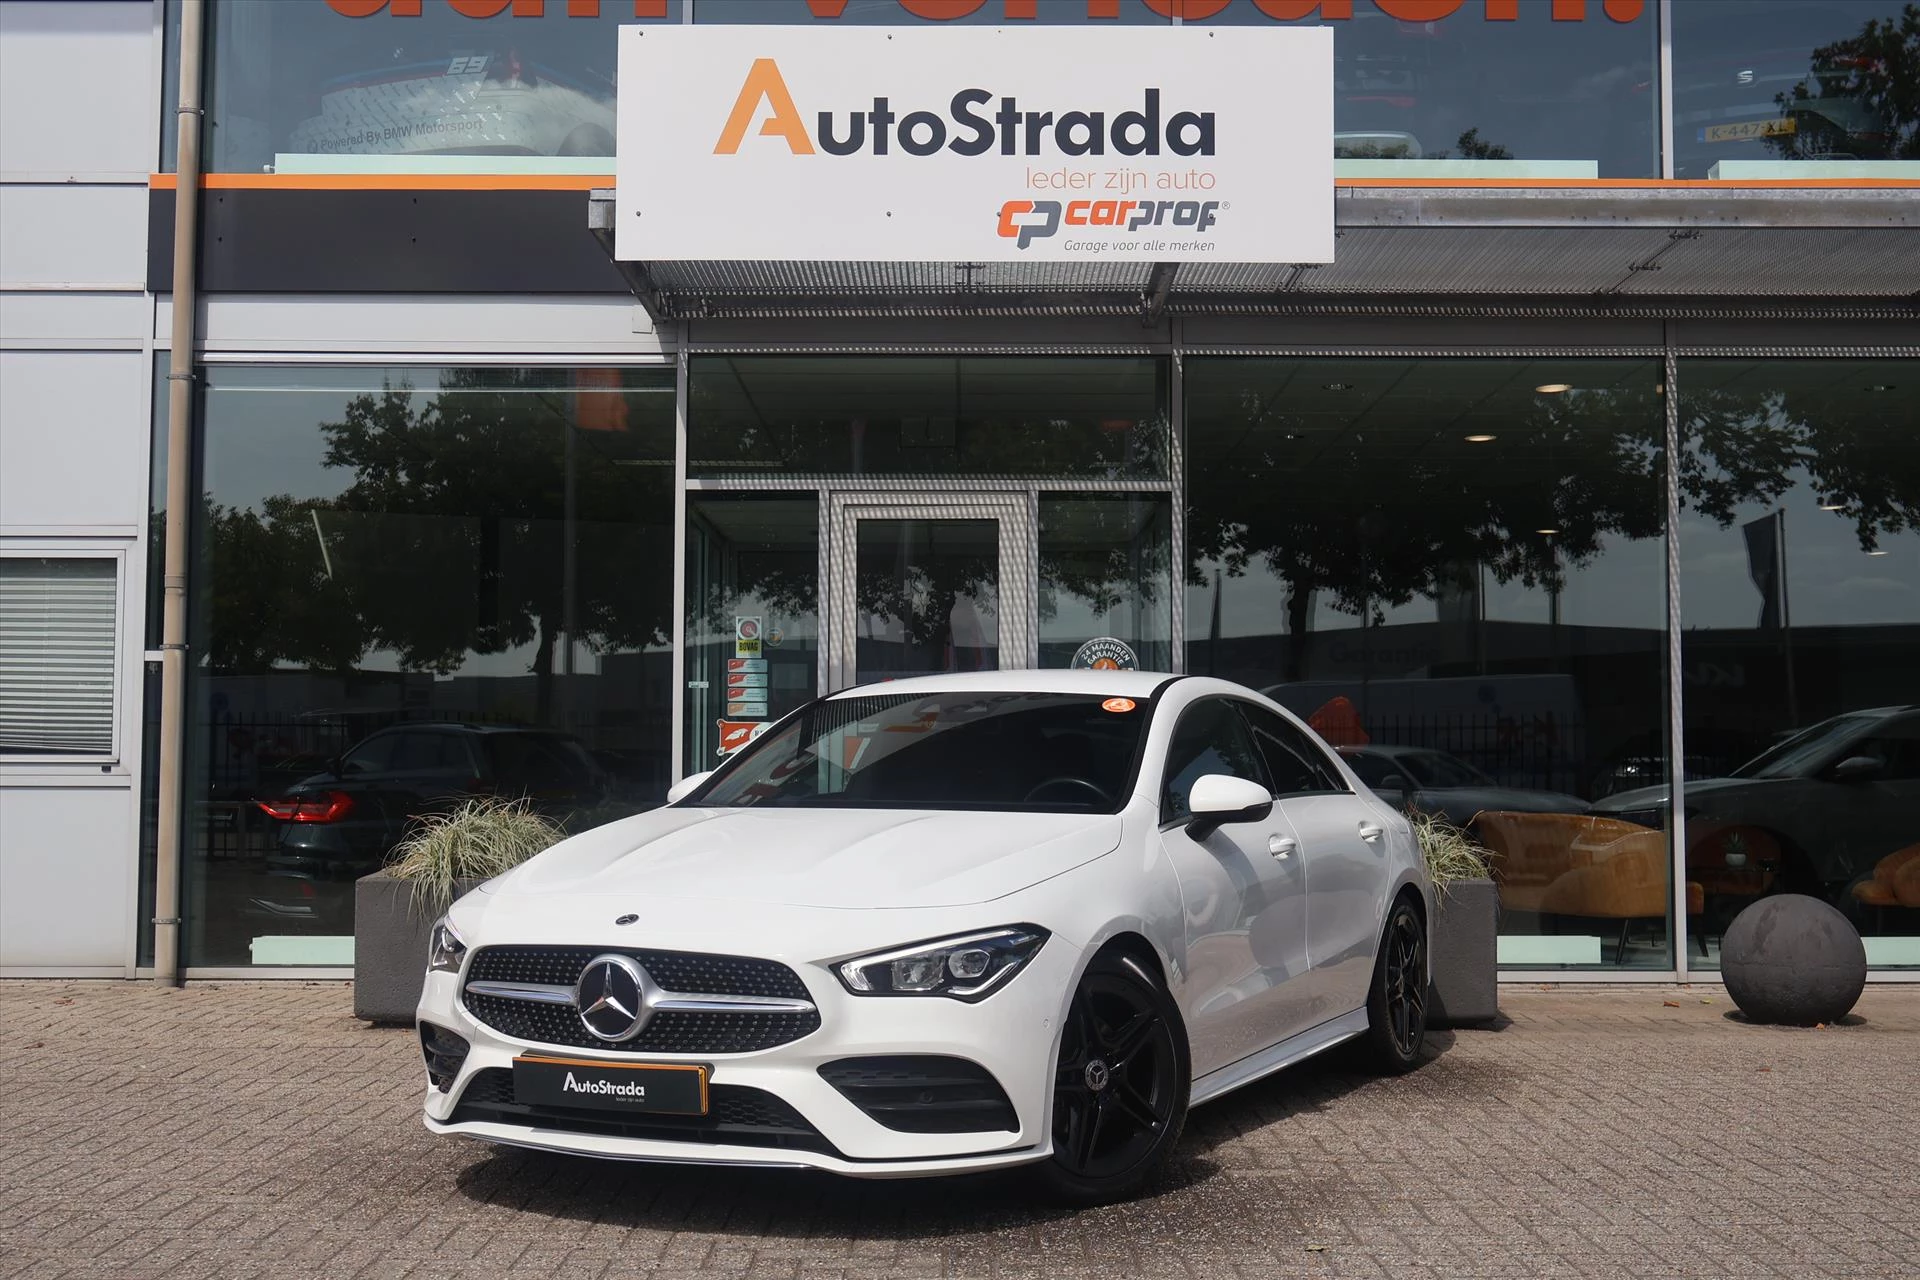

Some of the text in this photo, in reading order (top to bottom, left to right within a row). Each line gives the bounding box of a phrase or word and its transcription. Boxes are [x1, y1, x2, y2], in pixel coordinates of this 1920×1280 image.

[447, 56, 488, 75] 69
[712, 58, 1216, 156] AutoStrada
[321, 118, 484, 150] Powered By BMW Motorsport
[1026, 167, 1216, 195] Ieder zijn auto
[1064, 239, 1215, 254] Garage voor alle merken
[1082, 643, 1131, 662] 24 MAANDEN
[1087, 650, 1125, 666] GARANTIE
[562, 1071, 645, 1096] AutoStrada
